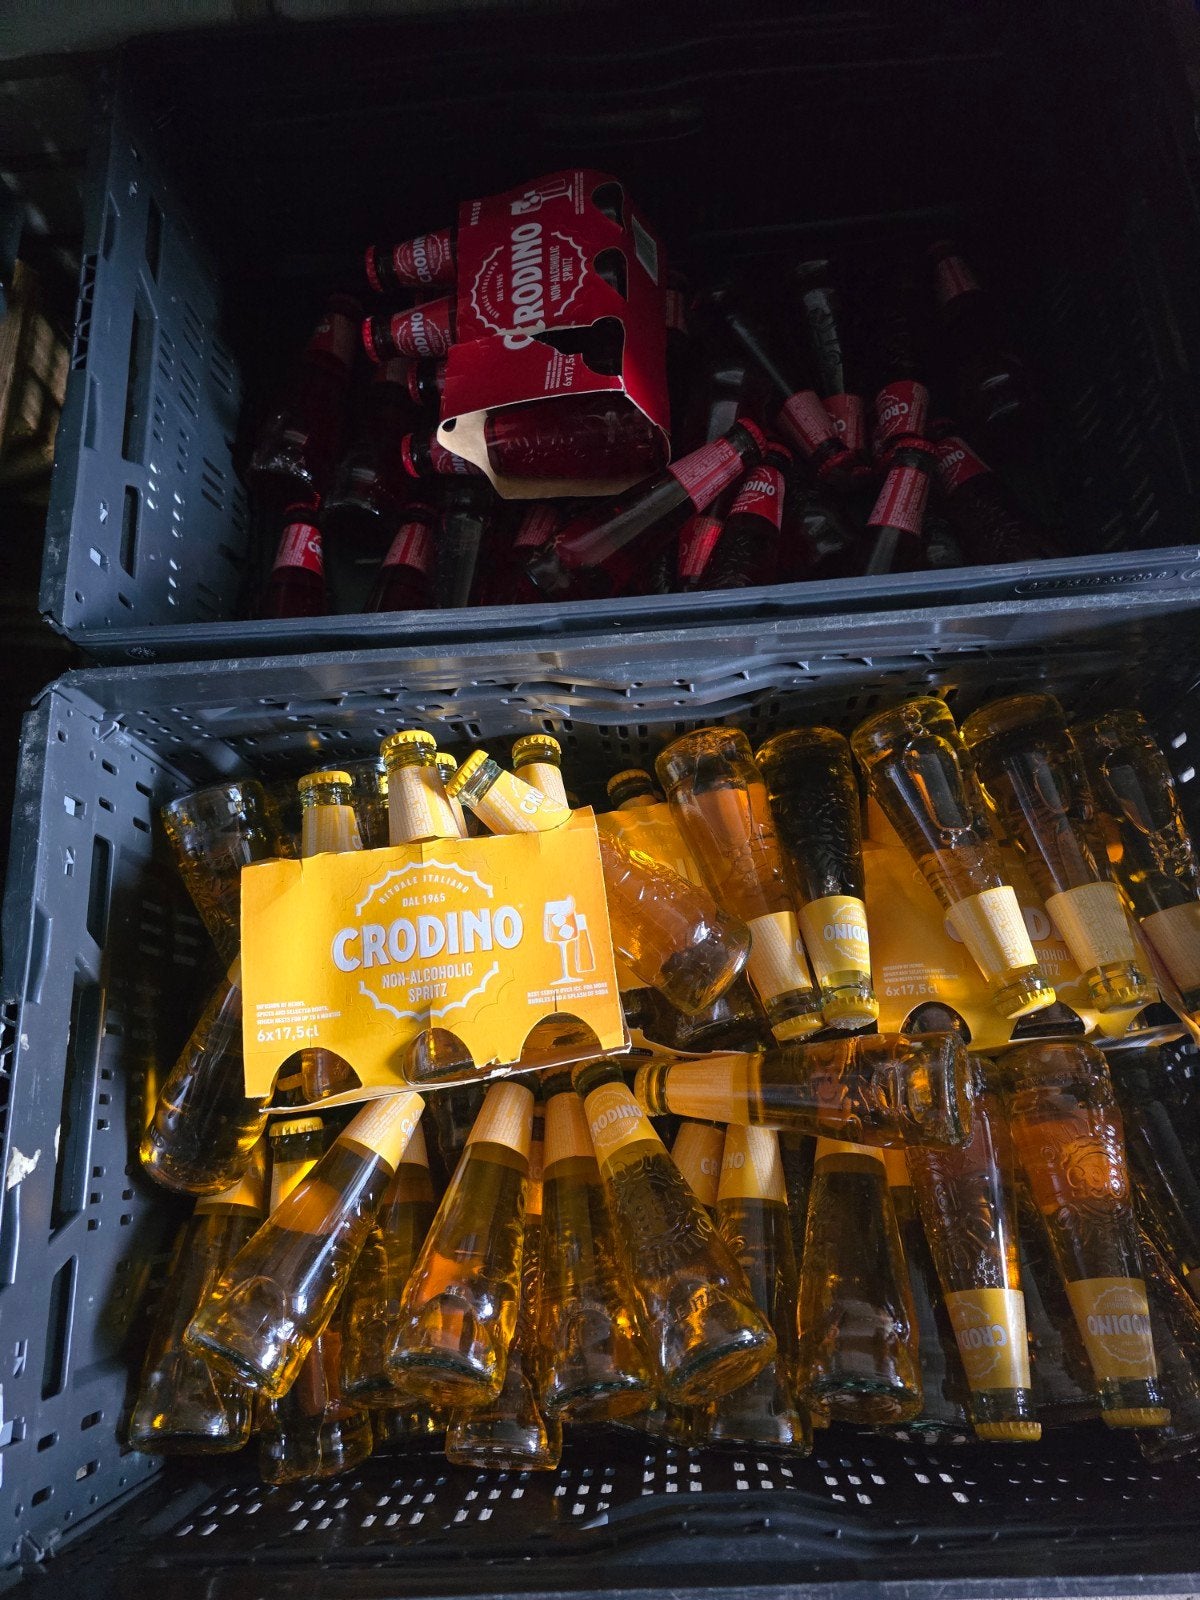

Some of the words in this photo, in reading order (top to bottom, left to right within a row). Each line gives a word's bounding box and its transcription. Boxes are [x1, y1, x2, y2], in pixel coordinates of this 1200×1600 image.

[481, 261, 499, 294] ITALIANO
[549, 245, 561, 301] NON-ALCOHOLIC
[562, 257, 573, 281] SPRITZ
[482, 295, 500, 319] RITUALE
[496, 288, 504, 302] DAL
[379, 876, 418, 904] RITUALE
[423, 874, 470, 893] ITALIANO
[402, 897, 420, 907] DAL
[423, 893, 445, 905] 1965
[332, 906, 523, 972] CRODINO
[382, 962, 473, 989] NON-ALCOHOLIC
[408, 983, 448, 1002] SPRITZ
[257, 1025, 319, 1042] 6x17,5cl
